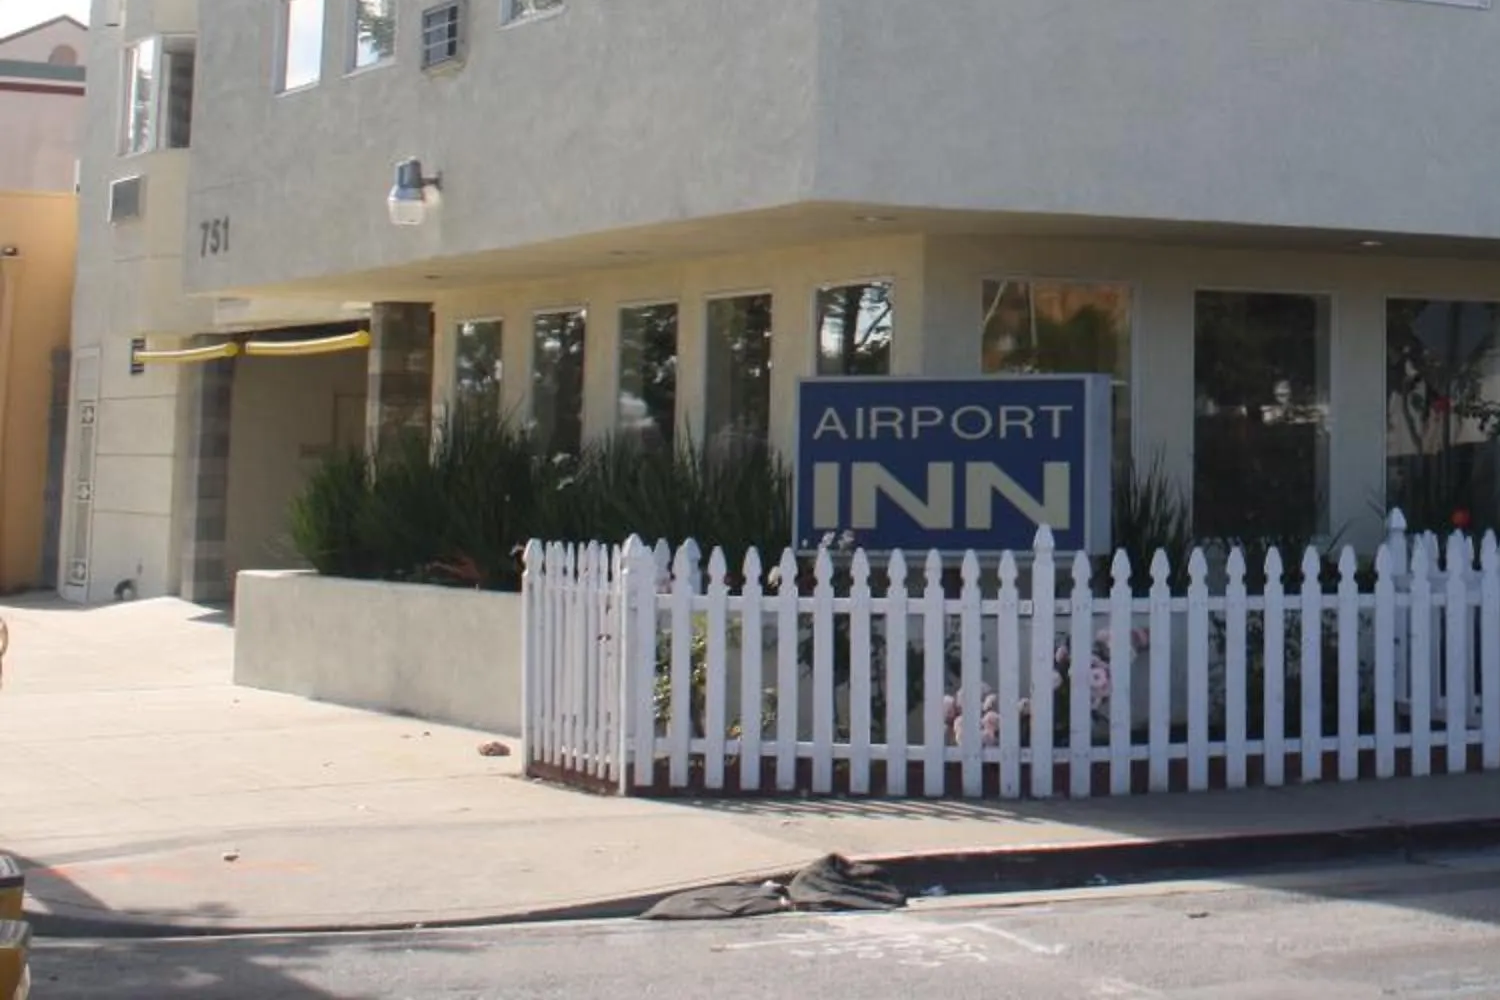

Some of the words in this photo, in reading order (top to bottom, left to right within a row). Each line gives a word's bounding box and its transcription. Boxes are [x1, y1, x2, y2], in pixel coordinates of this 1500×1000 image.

[200, 215, 229, 258] 751
[813, 405, 1073, 439] AIRPORT
[813, 461, 1070, 529] INN
